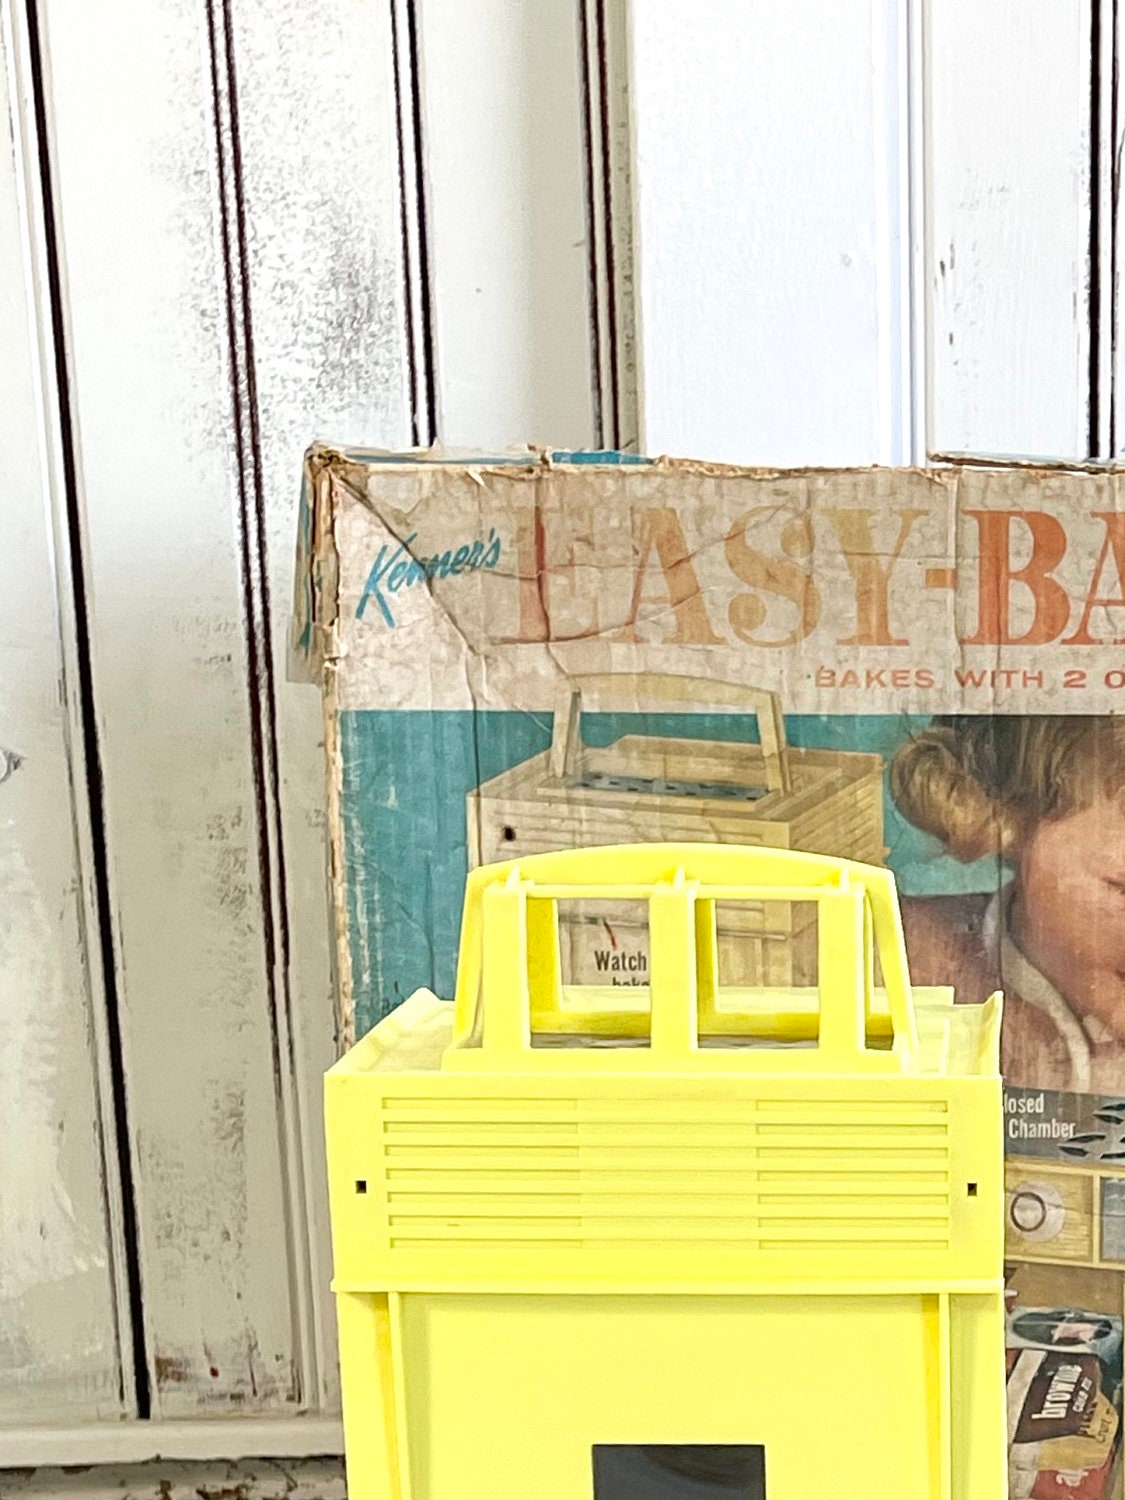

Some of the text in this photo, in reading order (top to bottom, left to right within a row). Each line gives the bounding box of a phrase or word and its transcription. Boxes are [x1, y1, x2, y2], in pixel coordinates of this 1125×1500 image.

[355, 527, 501, 628] Kenner's
[814, 669, 935, 689] BAKES
[954, 669, 1045, 689] WITH
[1062, 669, 1088, 689] 2
[594, 949, 647, 972] Watch
[1003, 1093, 1046, 1115] losed
[1008, 1118, 1077, 1140] Chamber
